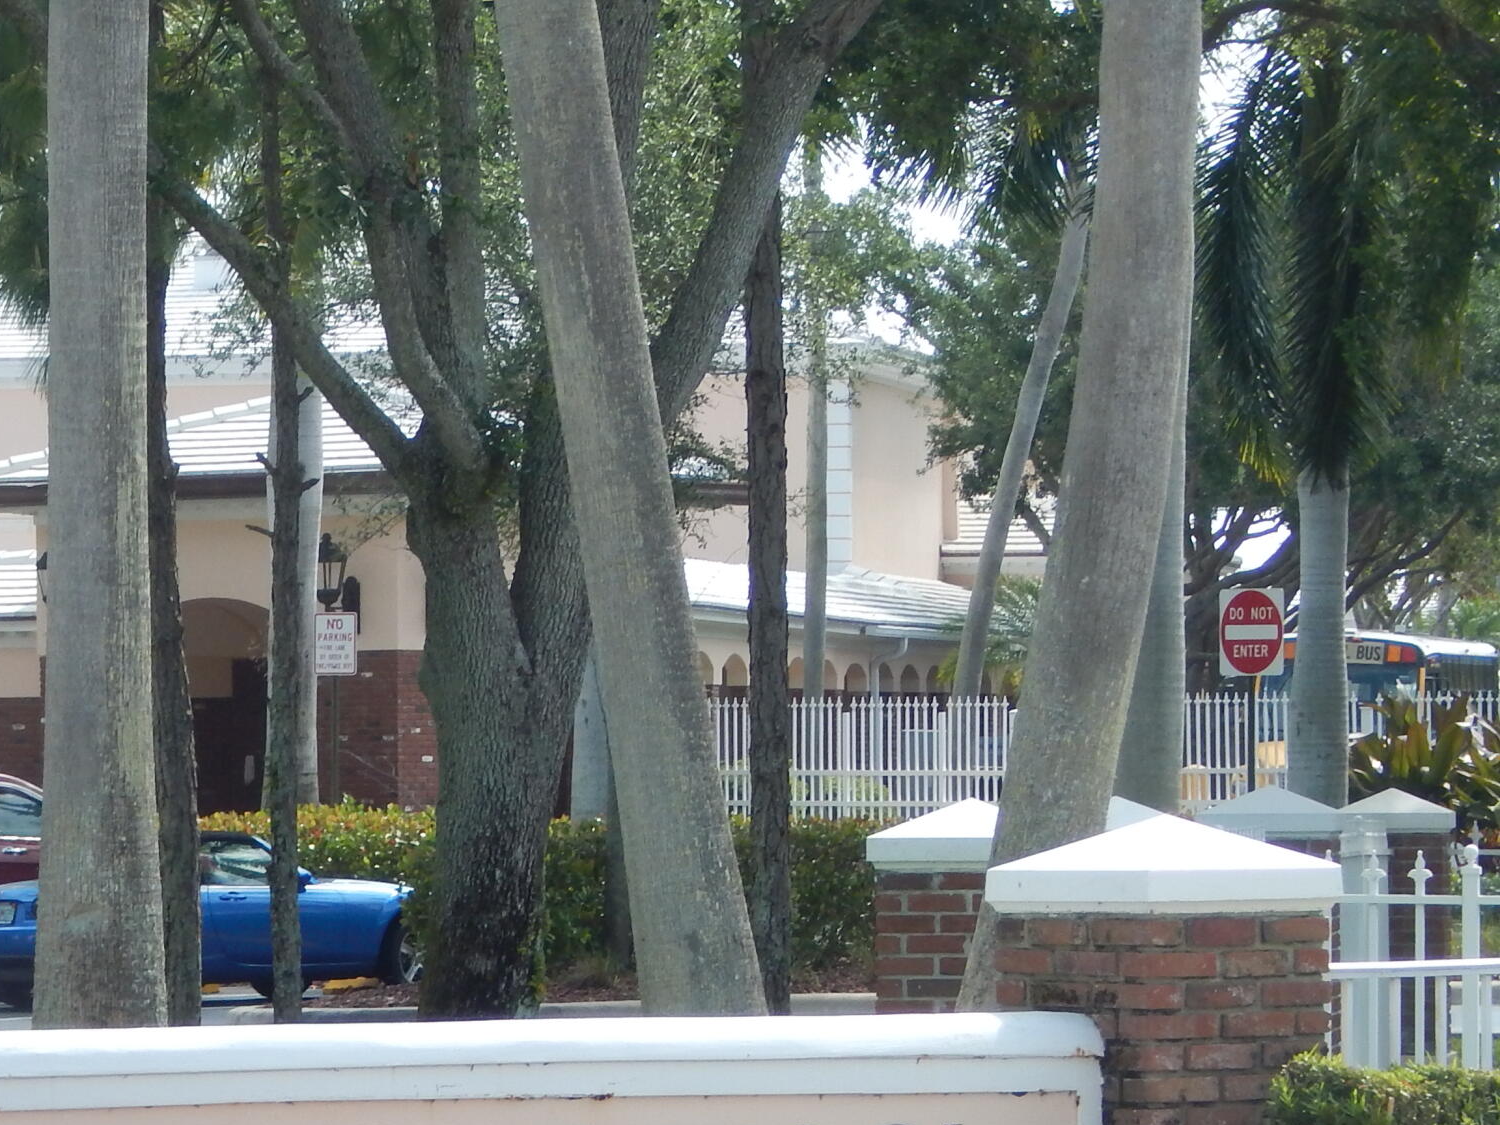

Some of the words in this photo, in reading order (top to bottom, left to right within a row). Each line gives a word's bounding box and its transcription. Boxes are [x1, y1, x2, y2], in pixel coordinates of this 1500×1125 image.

[1229, 607, 1244, 621] DO
[1250, 606, 1274, 620] NOT
[326, 618, 343, 630] NO
[317, 632, 353, 641] PARKING
[1233, 644, 1268, 658] ENTER
[1356, 645, 1381, 661] BUS
